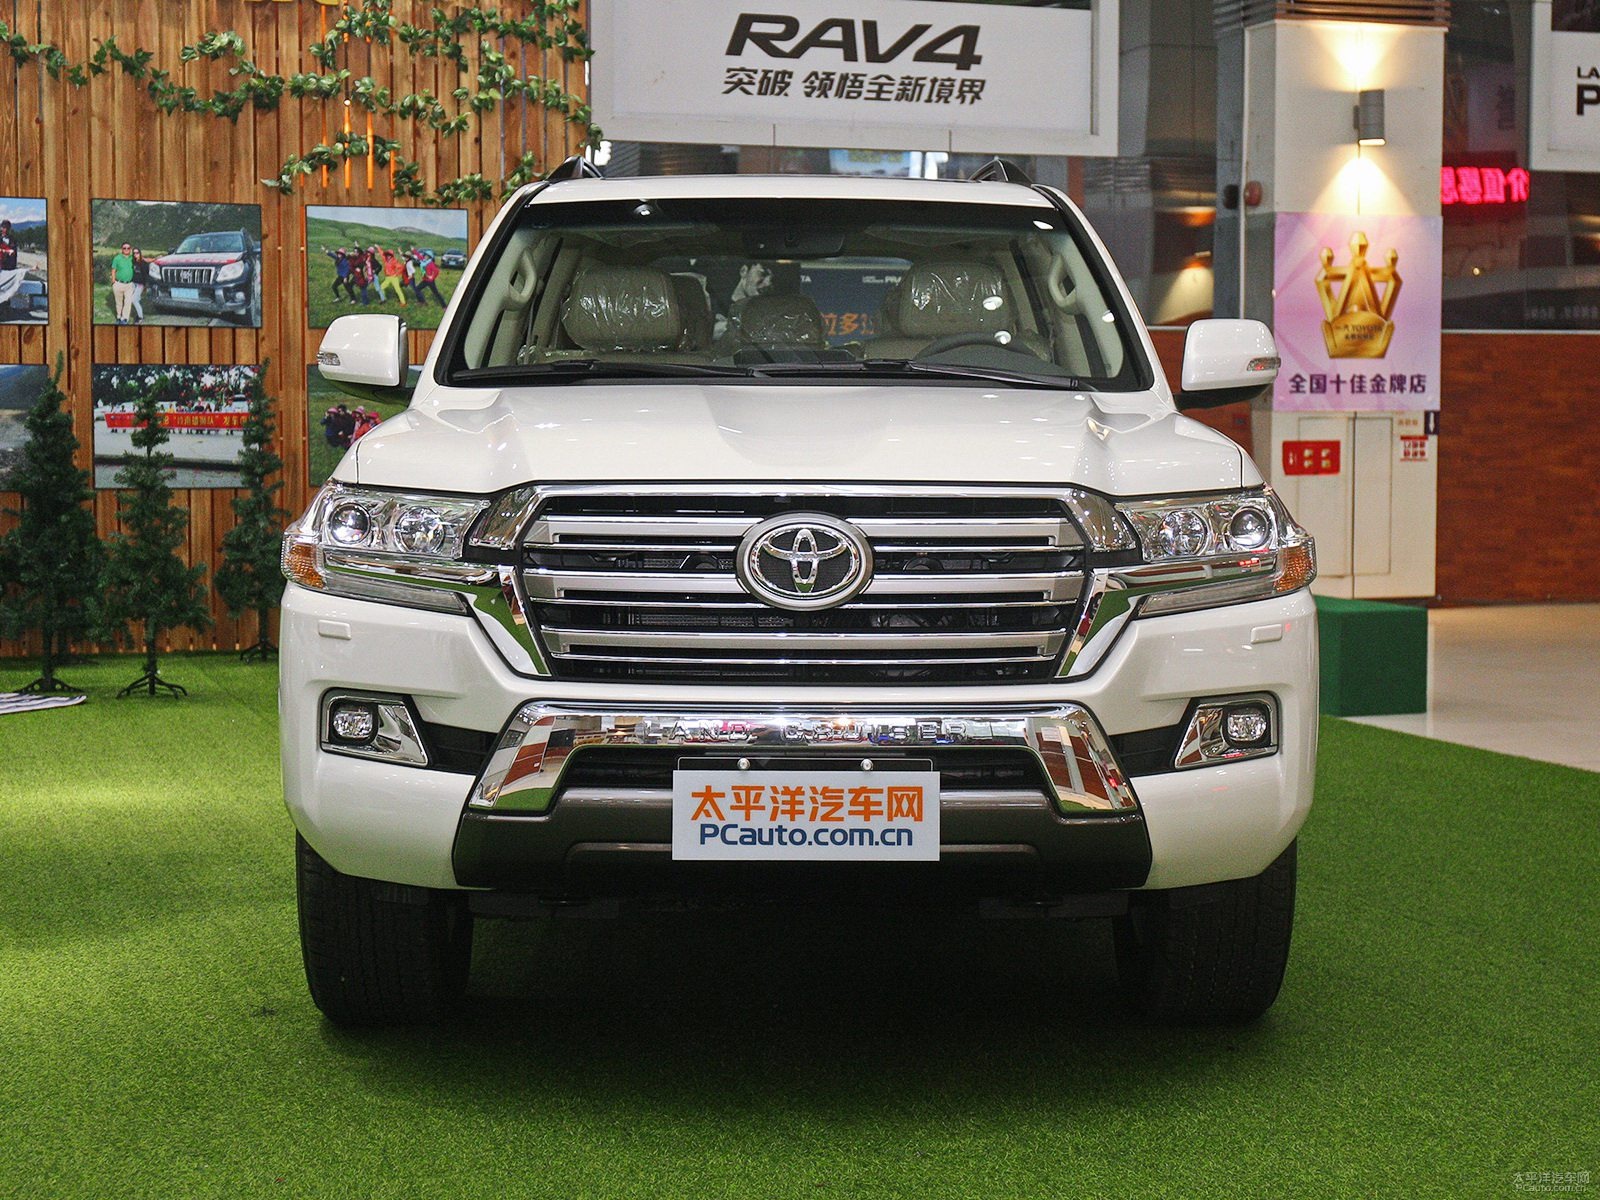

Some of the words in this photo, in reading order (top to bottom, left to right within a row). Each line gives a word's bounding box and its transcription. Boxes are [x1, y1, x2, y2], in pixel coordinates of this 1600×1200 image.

[725, 12, 983, 71] RAV4
[721, 66, 794, 98] 突破
[801, 69, 986, 105] 领悟全新境界
[1288, 373, 1428, 395] 全国十佳金牌店
[690, 785, 924, 822] 太平洋汽车网
[699, 823, 913, 846] PCauto.com.cn
